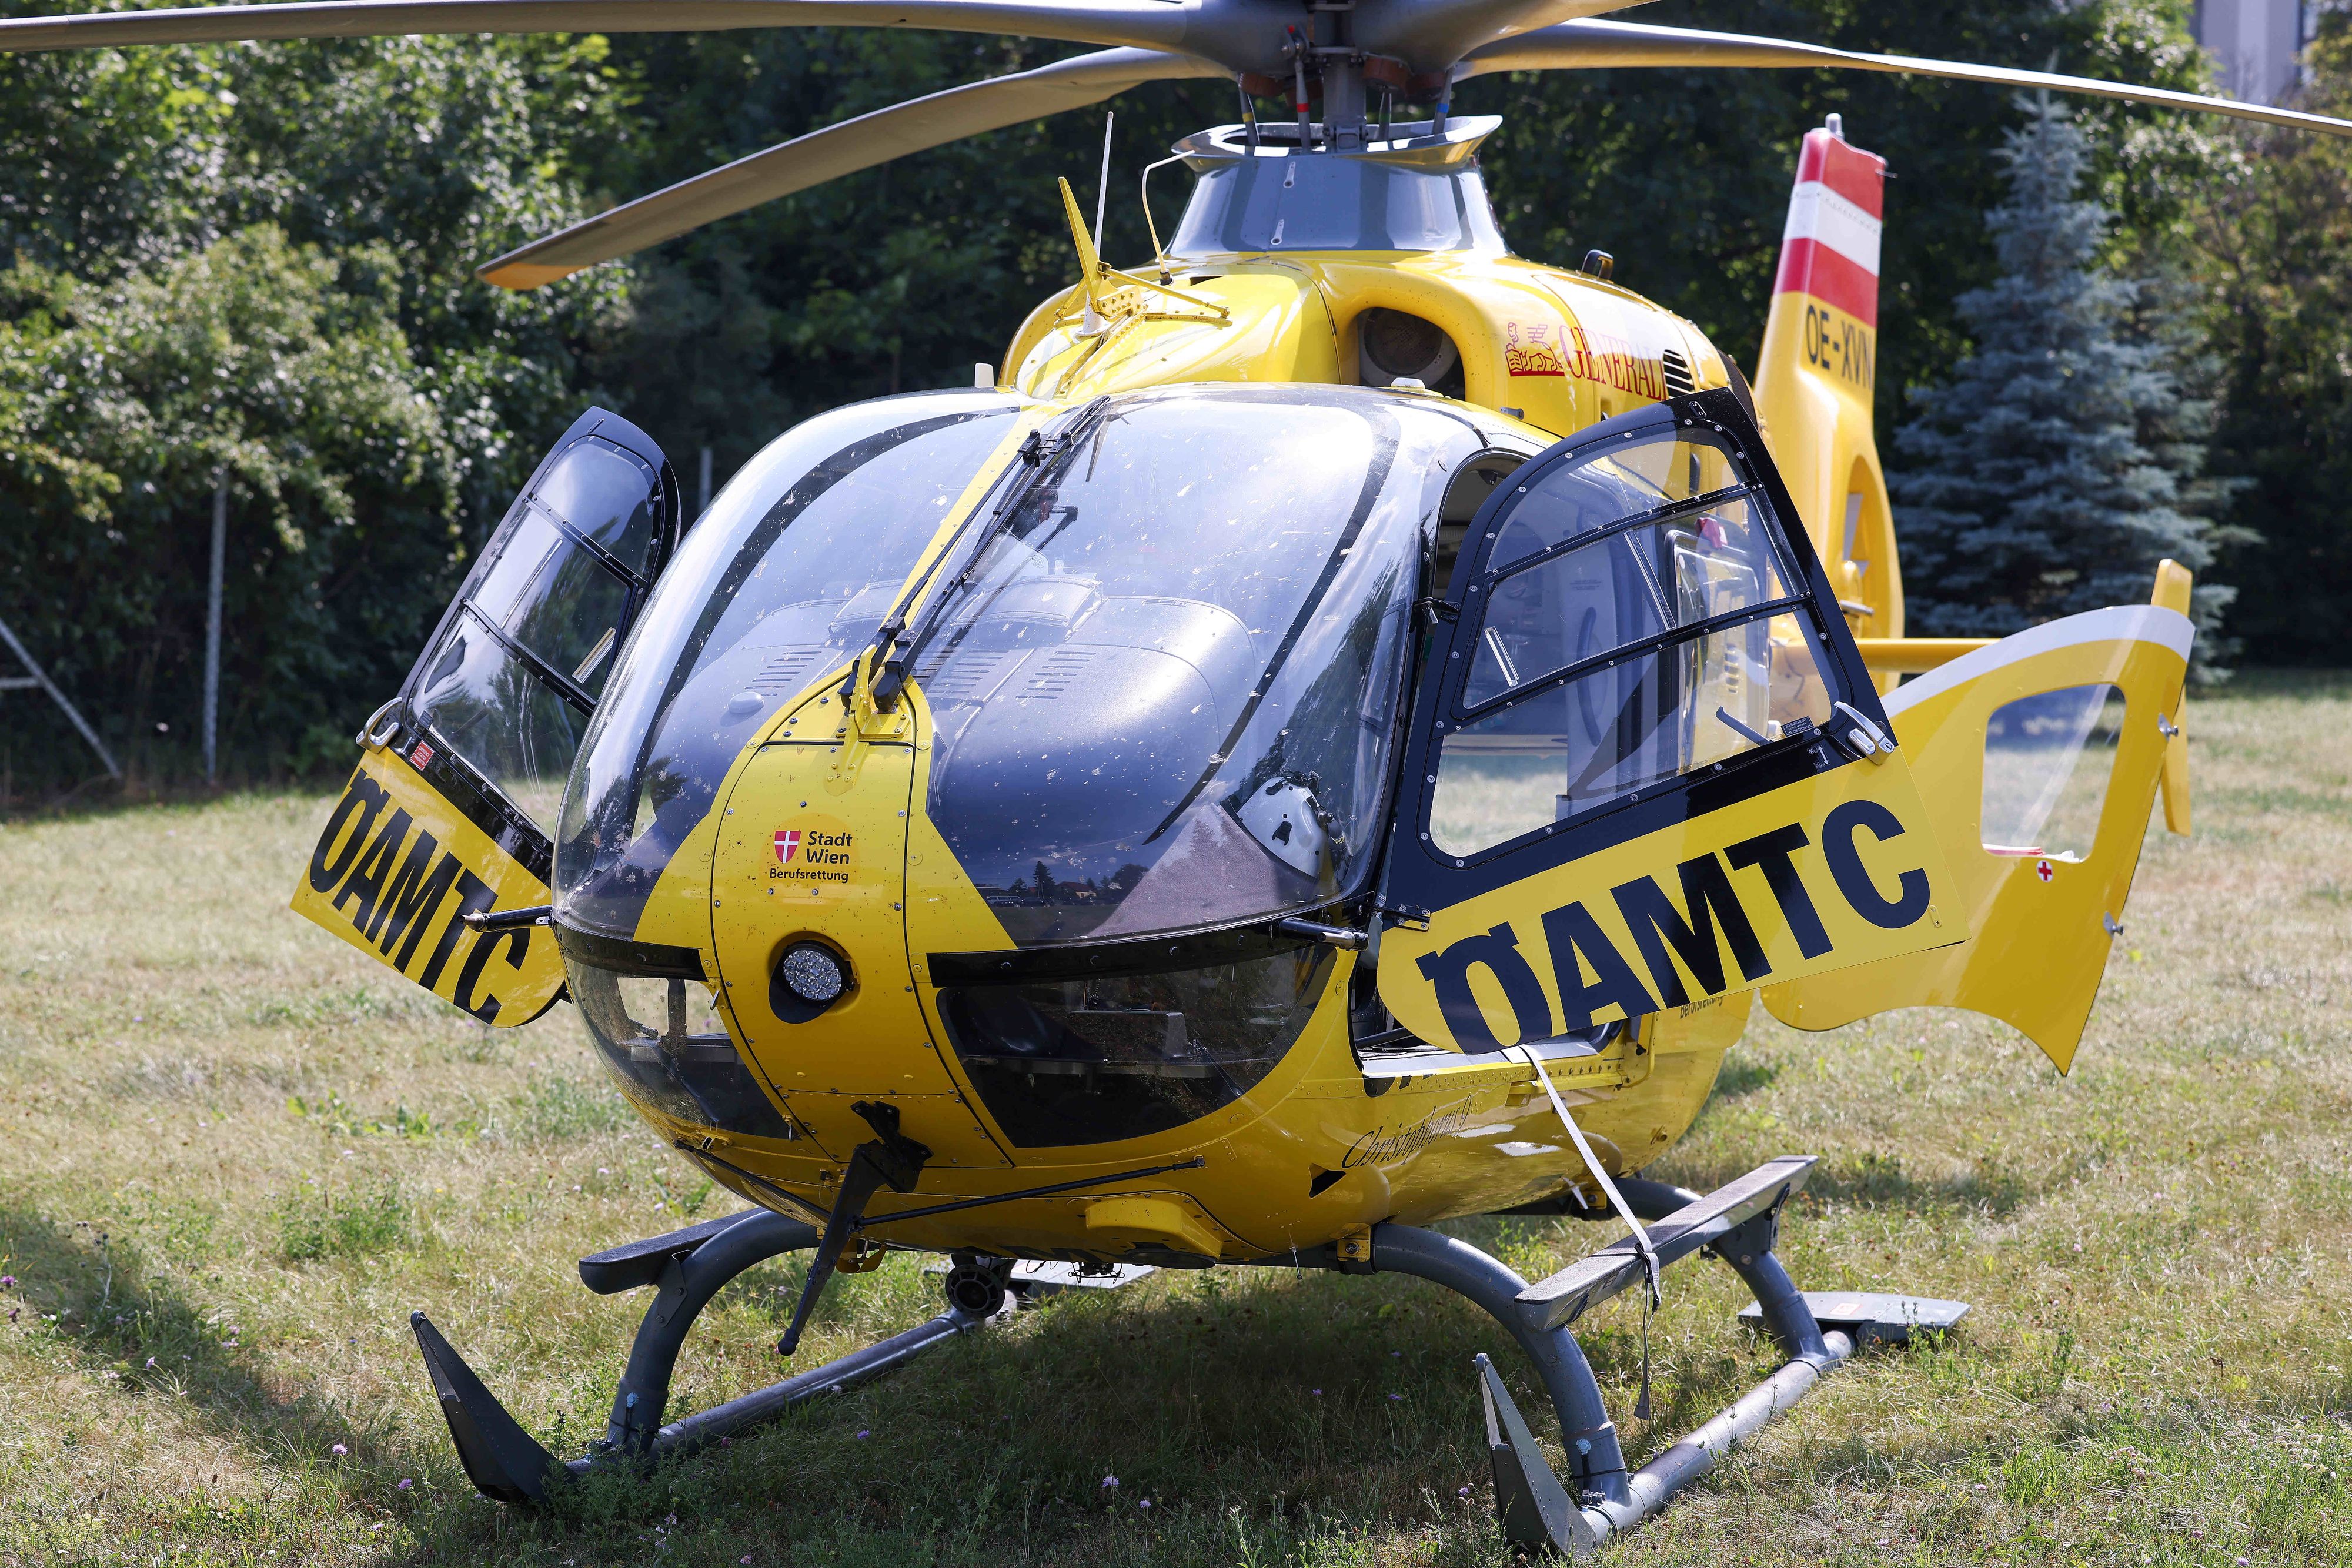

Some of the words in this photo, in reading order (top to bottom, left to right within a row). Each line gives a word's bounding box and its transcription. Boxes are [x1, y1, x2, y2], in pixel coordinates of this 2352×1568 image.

[1559, 325, 1669, 401] GENERALI
[808, 831, 853, 847] Stadt
[806, 848, 850, 864] Wien
[770, 868, 848, 884] Berufsrettung
[1341, 1105, 1460, 1169] Christophorus
[1457, 1095, 1472, 1134] 9
